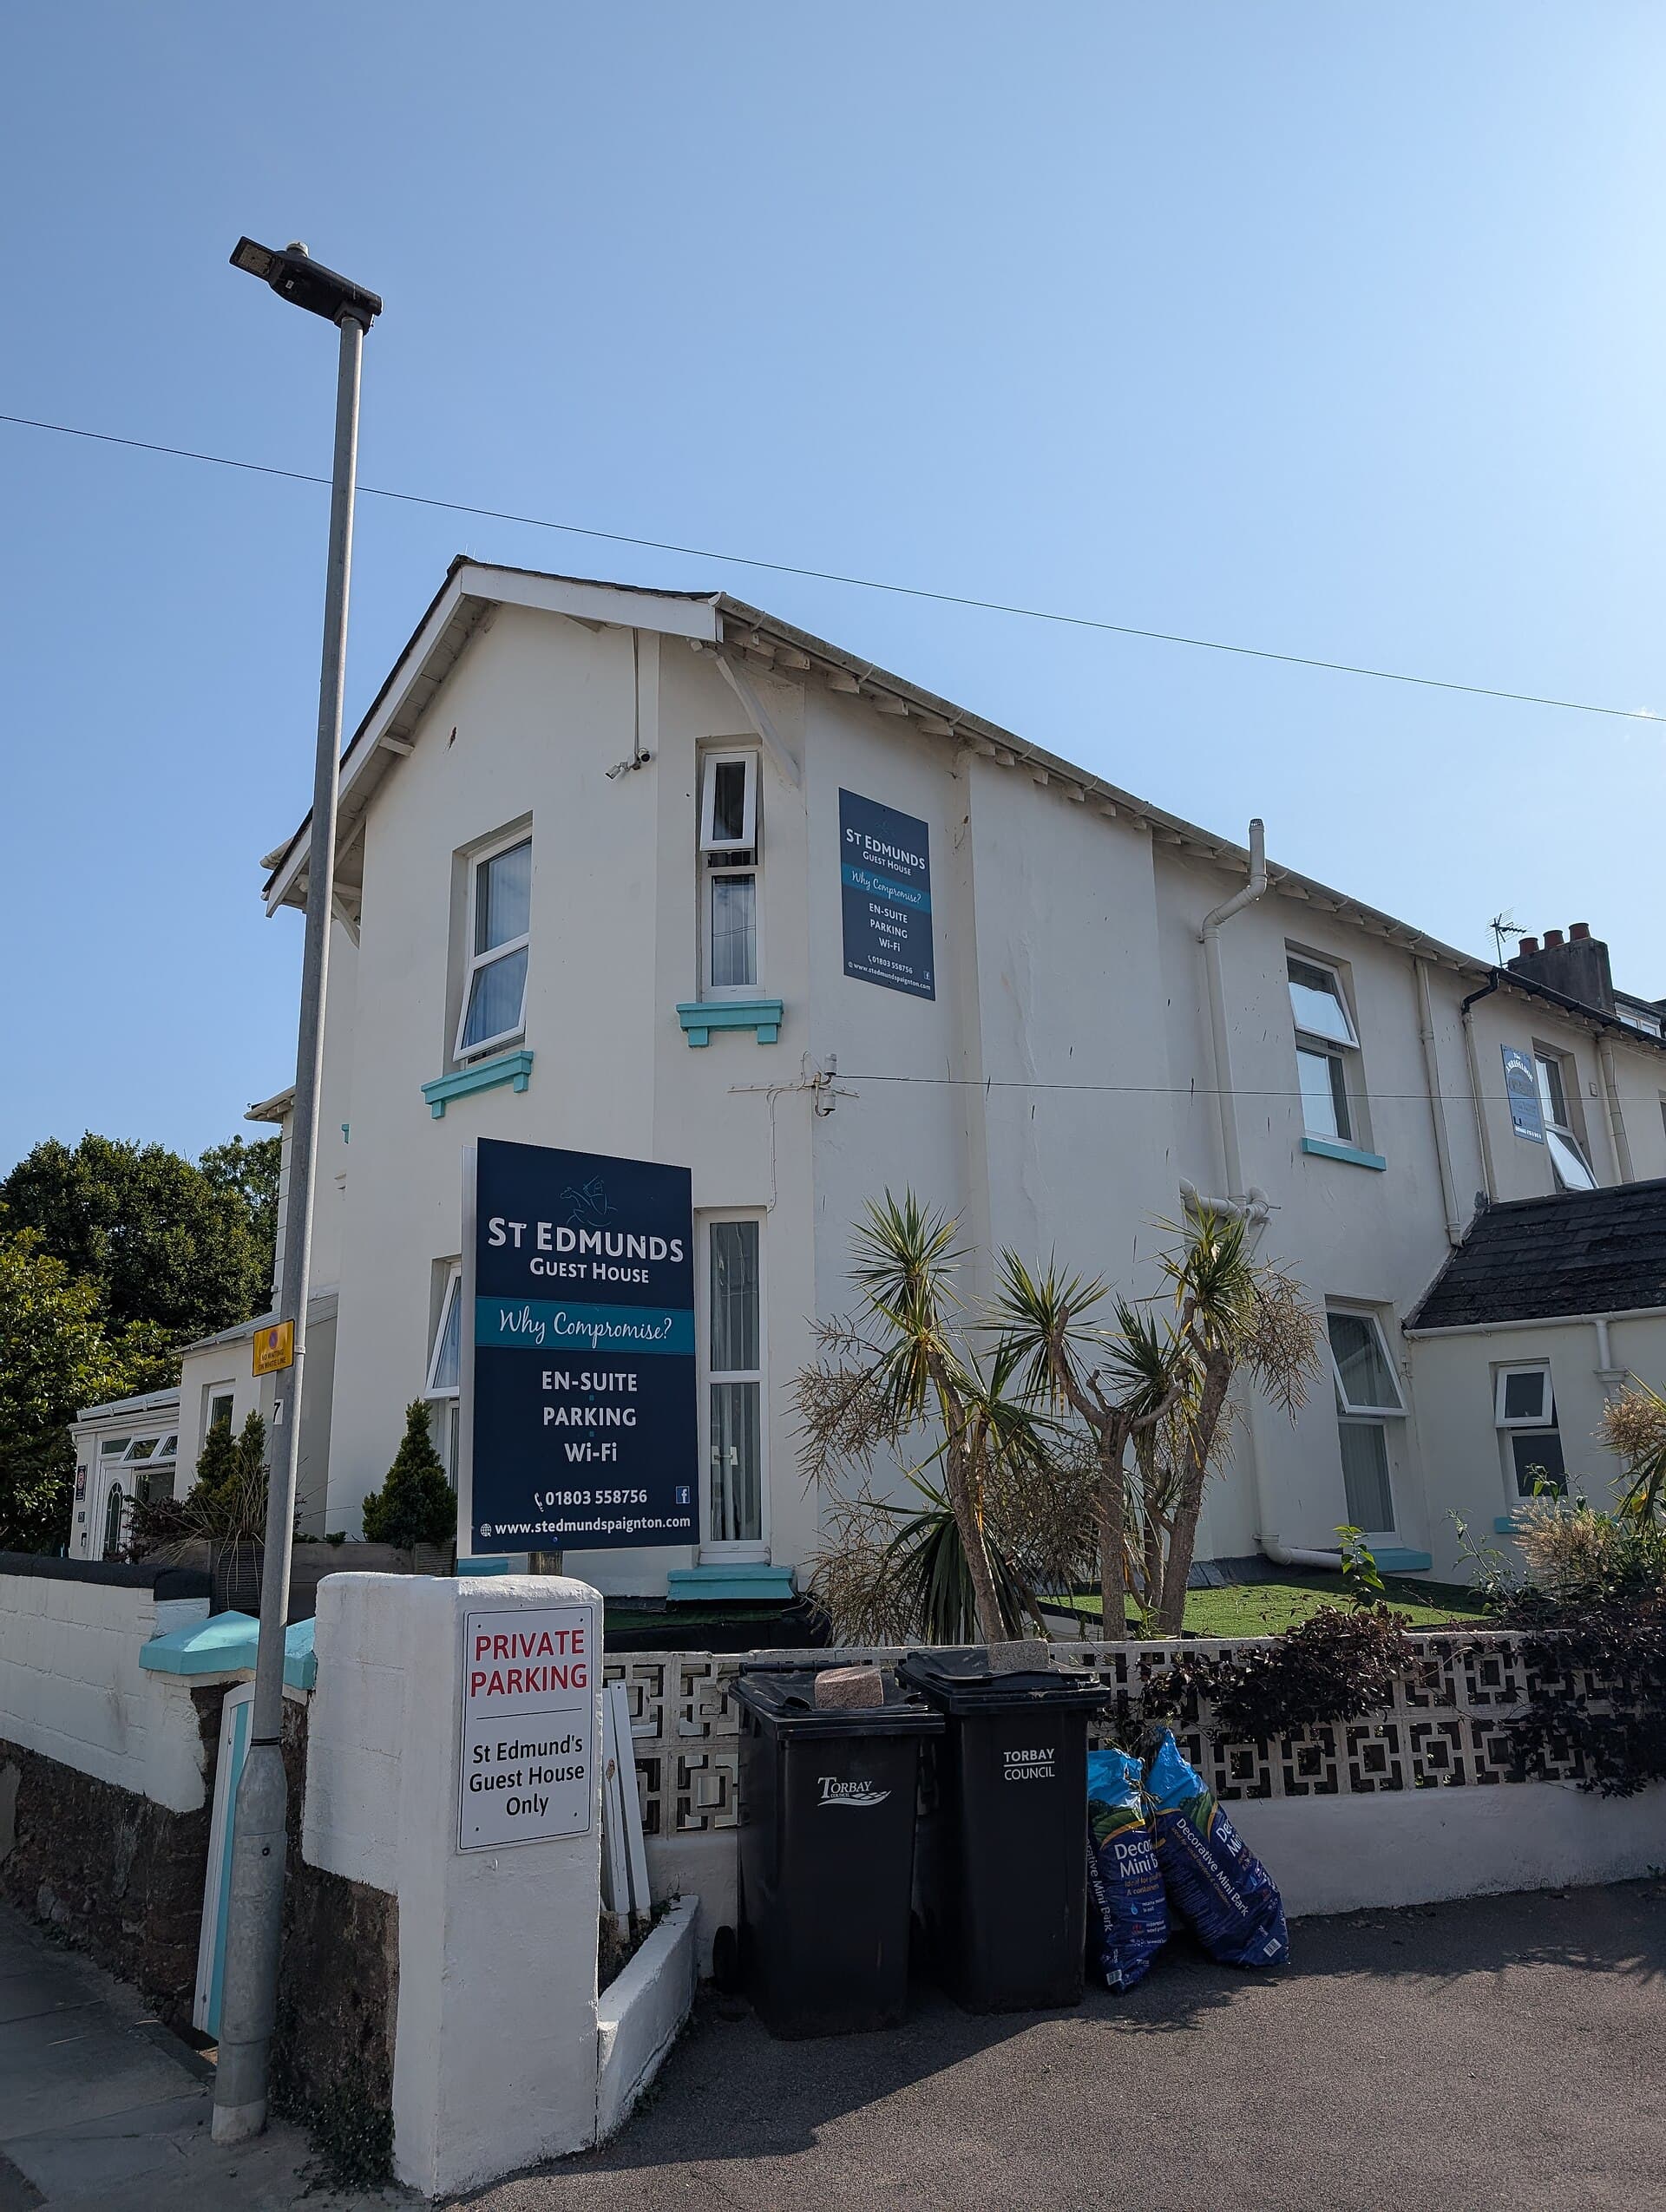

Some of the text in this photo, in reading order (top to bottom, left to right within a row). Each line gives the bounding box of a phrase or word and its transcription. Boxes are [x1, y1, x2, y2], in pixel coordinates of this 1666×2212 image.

[863, 851, 911, 876] GUEST HOUSE
[865, 835, 925, 870] EDMUNDS
[852, 870, 922, 904] Why Compromise?
[869, 903, 908, 923] EN-SUITE
[870, 919, 908, 939] PARKING
[879, 937, 901, 952] Wi-Fi
[872, 956, 913, 974] 01803 558756
[537, 1221, 684, 1262] EDMUNDS
[529, 1258, 649, 1283] GUEST HOUSE
[500, 1306, 672, 1349] Why Compromise?
[541, 1371, 638, 1391] EN-SUITE
[273, 1402, 280, 1423] 7
[543, 1407, 637, 1426] PARKING
[564, 1443, 617, 1462] Wi-Fi
[545, 1489, 647, 1506] 01803 558756
[495, 1516, 691, 1535] www.stedmundspaignton.com
[475, 1629, 585, 1661] PRIVATE
[470, 1664, 587, 1698] PARKING
[472, 1735, 583, 1764] St Edmund's
[1003, 1748, 1055, 1763] TORBAY
[469, 1764, 585, 1792] Guest House
[1004, 1766, 1055, 1781] COUNCIL
[506, 1793, 549, 1817] Only
[1120, 1855, 1151, 1878] Mini
[1177, 1817, 1217, 1872] Decorative
[1216, 1869, 1234, 1897] Mini
[1230, 1891, 1250, 1917] Bark
[1092, 1880, 1106, 1907] Mini
[1100, 1908, 1113, 1933] Bark
